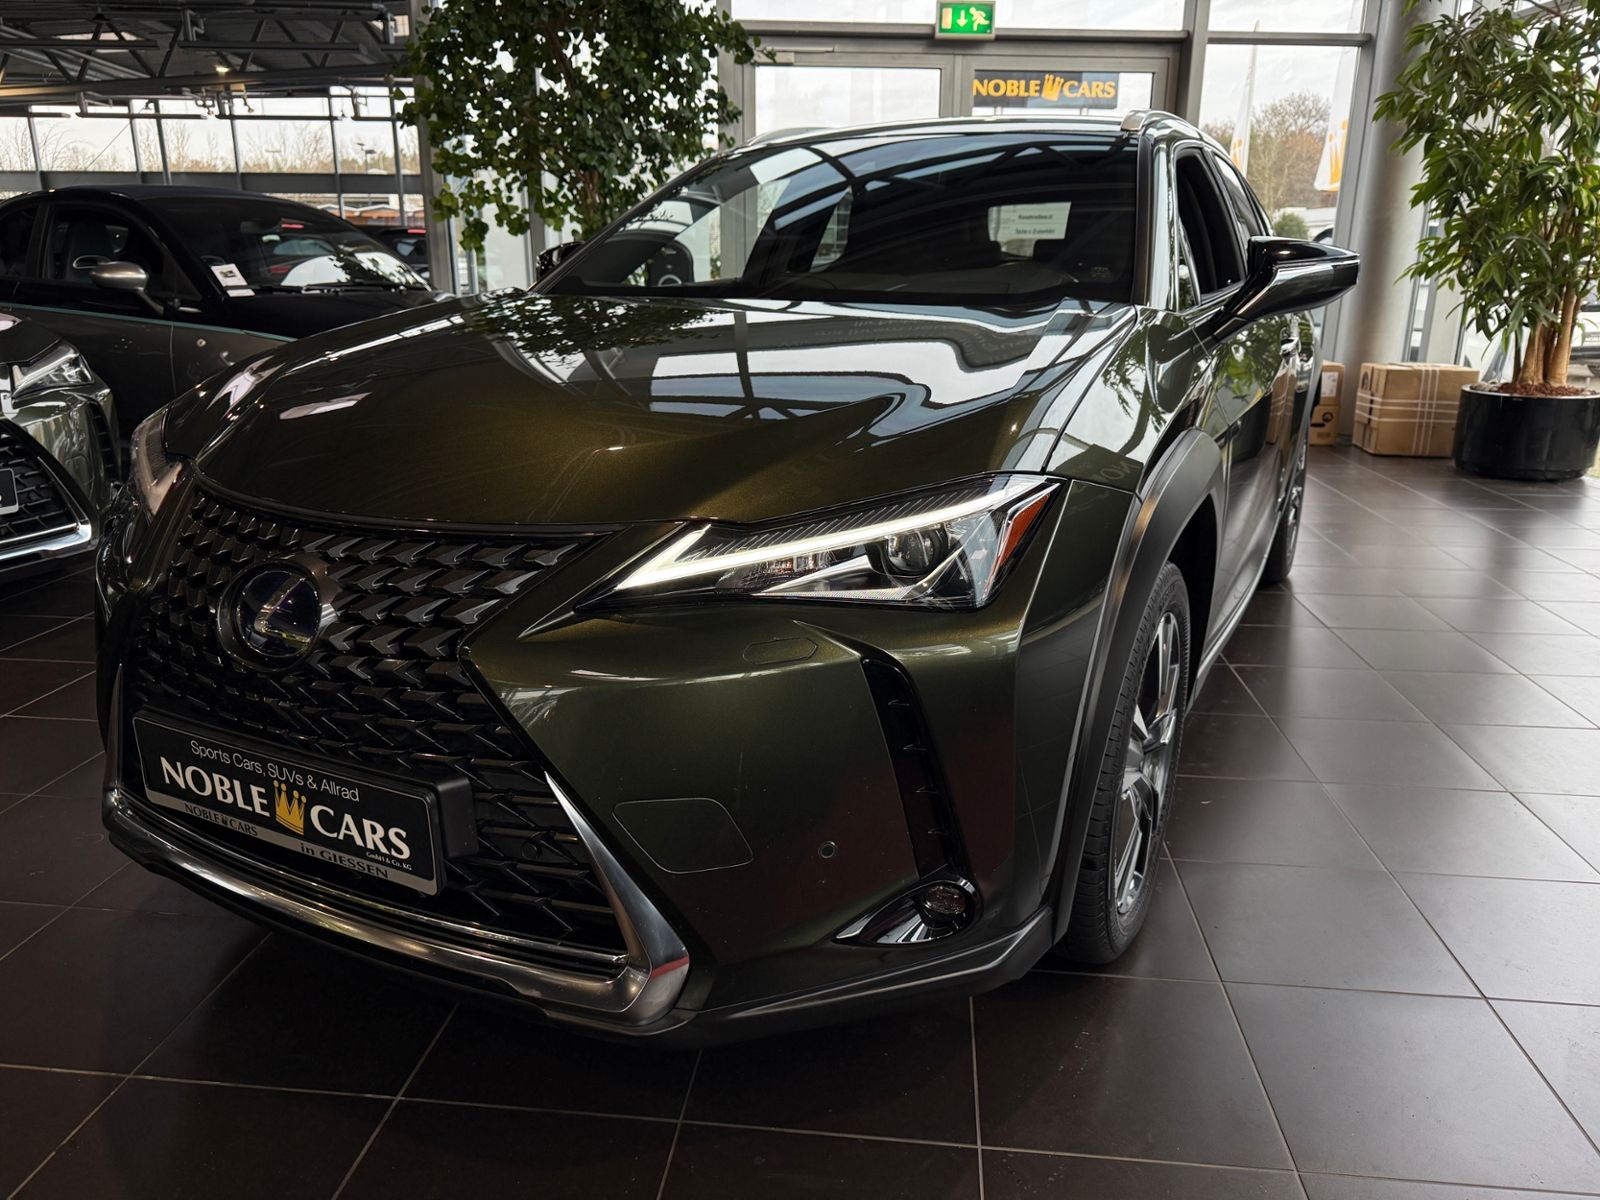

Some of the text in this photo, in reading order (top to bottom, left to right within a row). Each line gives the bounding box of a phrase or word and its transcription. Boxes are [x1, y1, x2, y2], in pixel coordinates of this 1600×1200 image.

[972, 79, 1116, 98] NOBLE CARS
[190, 740, 360, 802] Sports Cars, SUVs & Allrad
[160, 756, 411, 860] NOBLE CARS
[185, 803, 258, 837] NOBLE CARS
[300, 842, 389, 879] in GIESSEN
